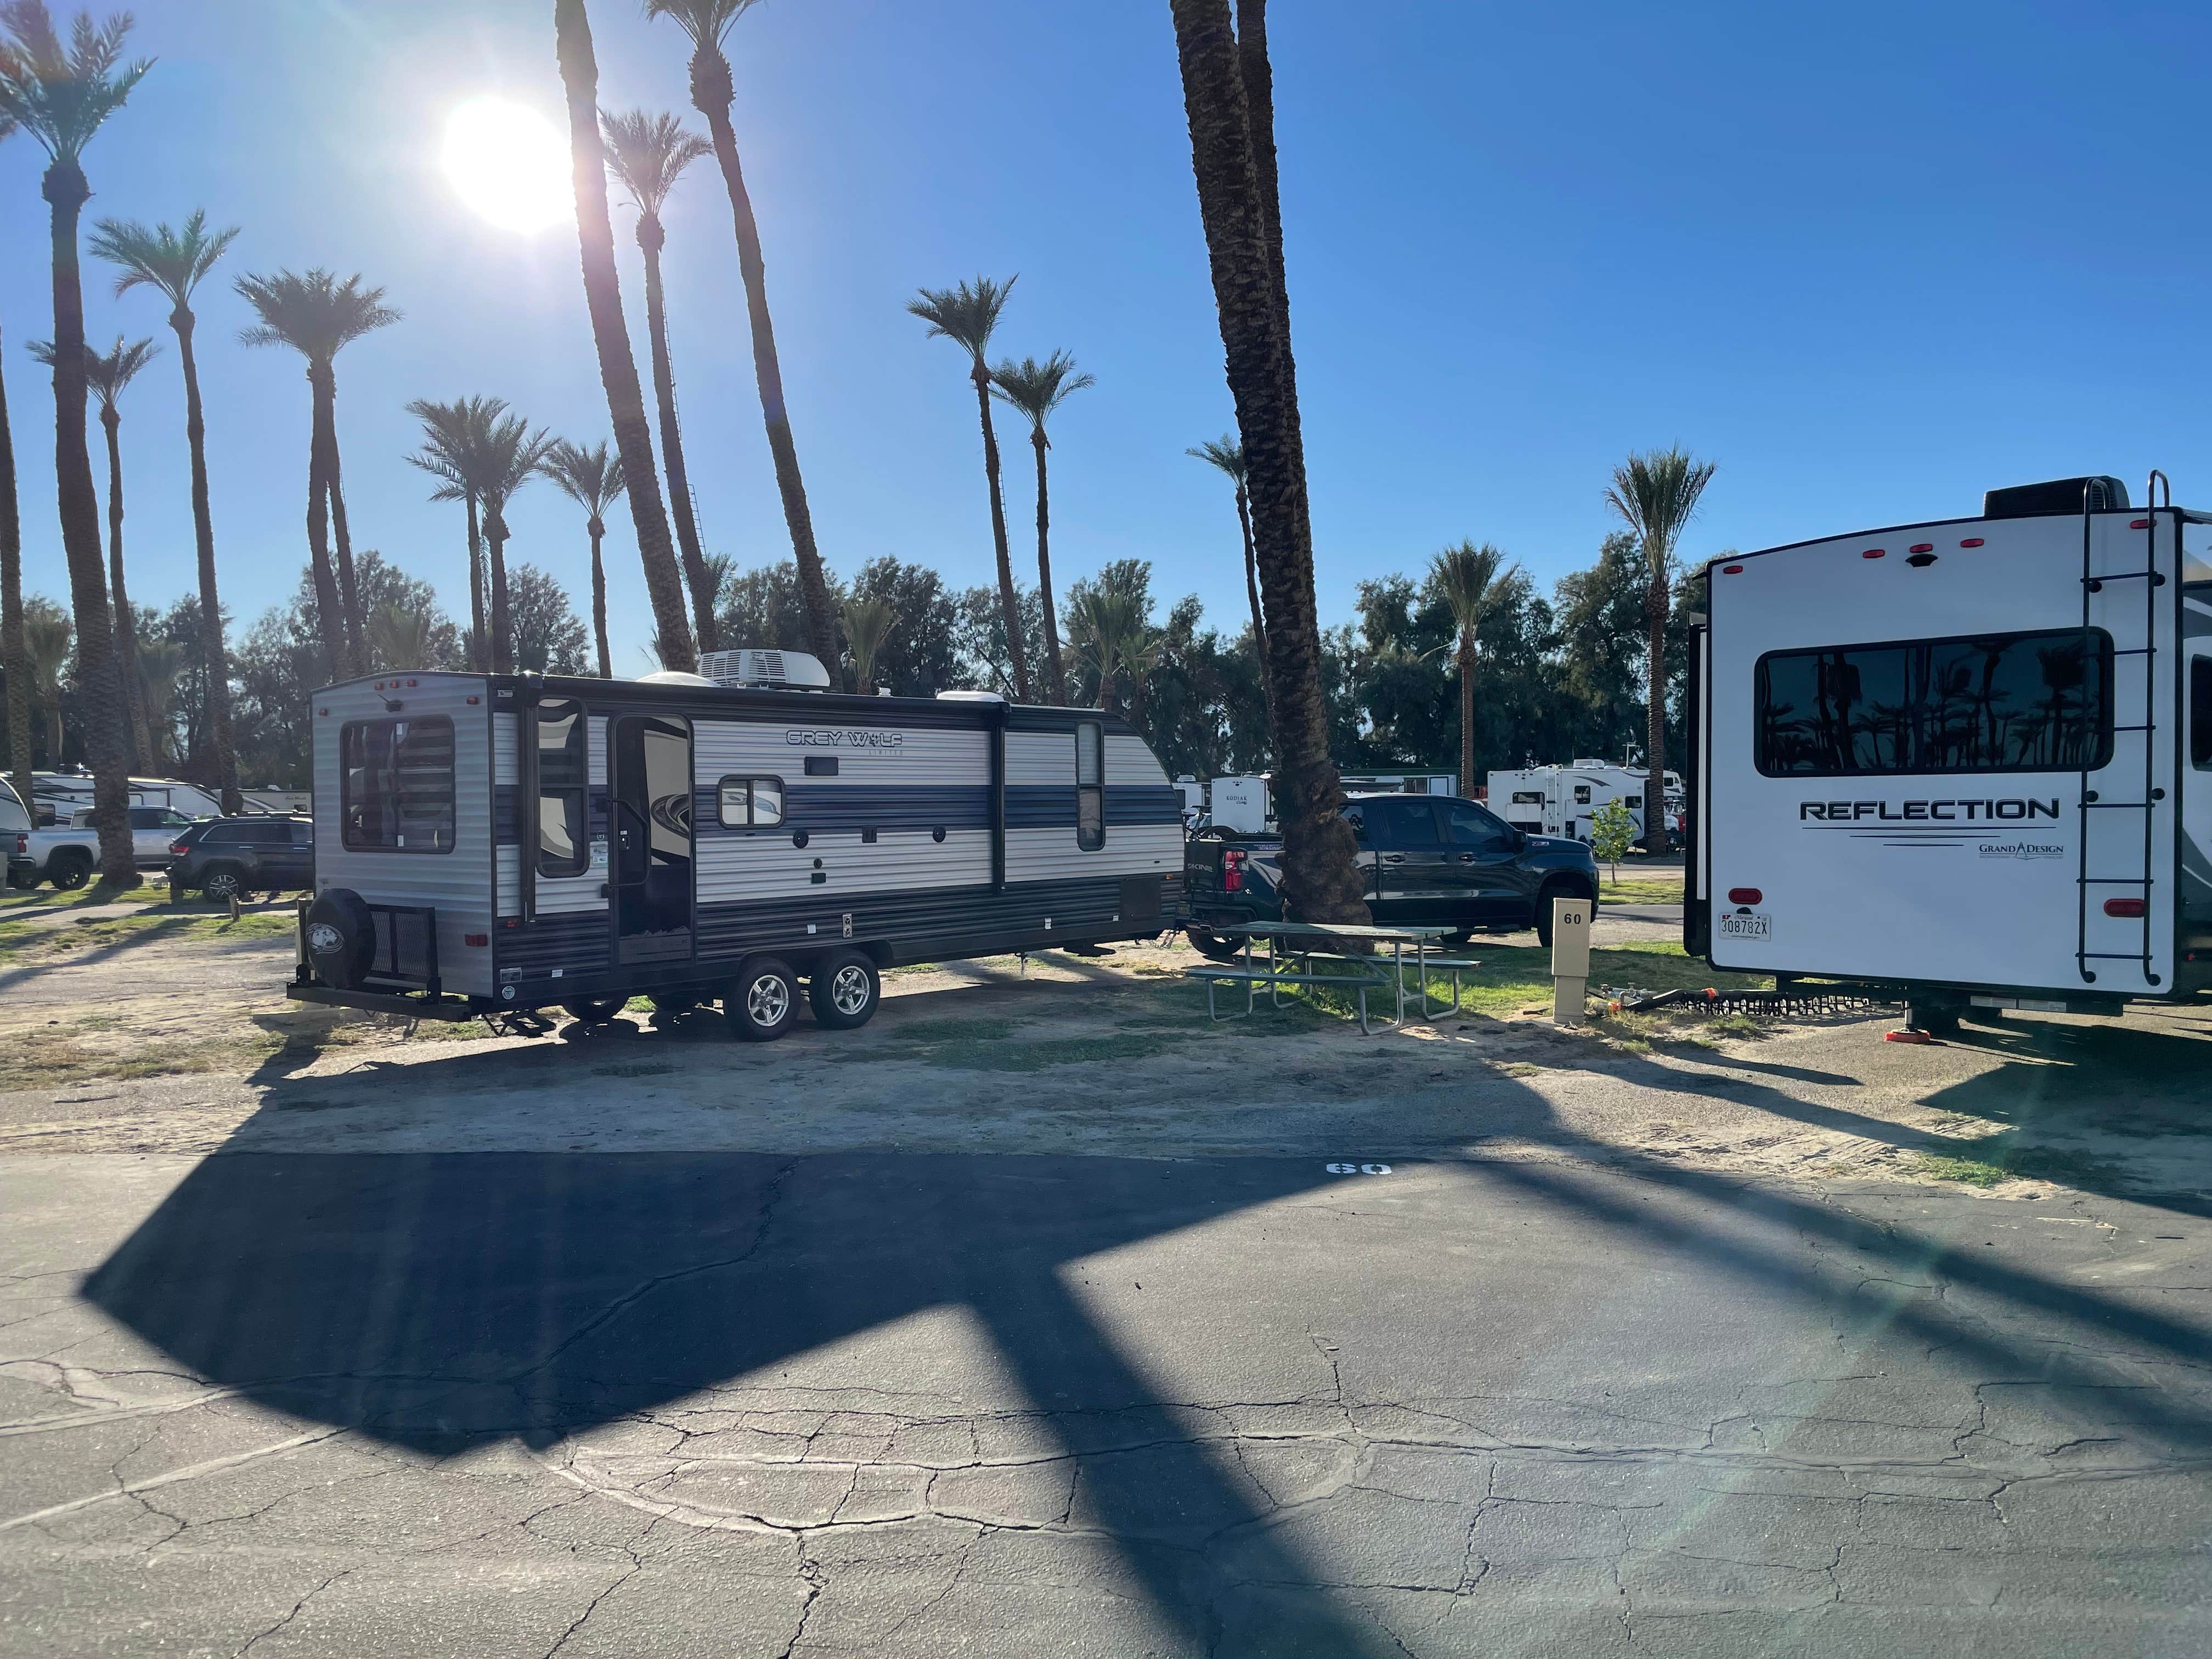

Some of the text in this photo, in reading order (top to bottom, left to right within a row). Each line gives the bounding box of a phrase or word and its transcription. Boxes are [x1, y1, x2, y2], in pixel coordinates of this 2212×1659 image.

[786, 730, 842, 746] GREY
[1800, 798, 2059, 820] REFLECTION
[1979, 844, 2064, 853] GRAND DESIGN
[1564, 913, 1581, 924] 60
[1722, 919, 1767, 935] 308782X
[1326, 1163, 1392, 1175] 60
